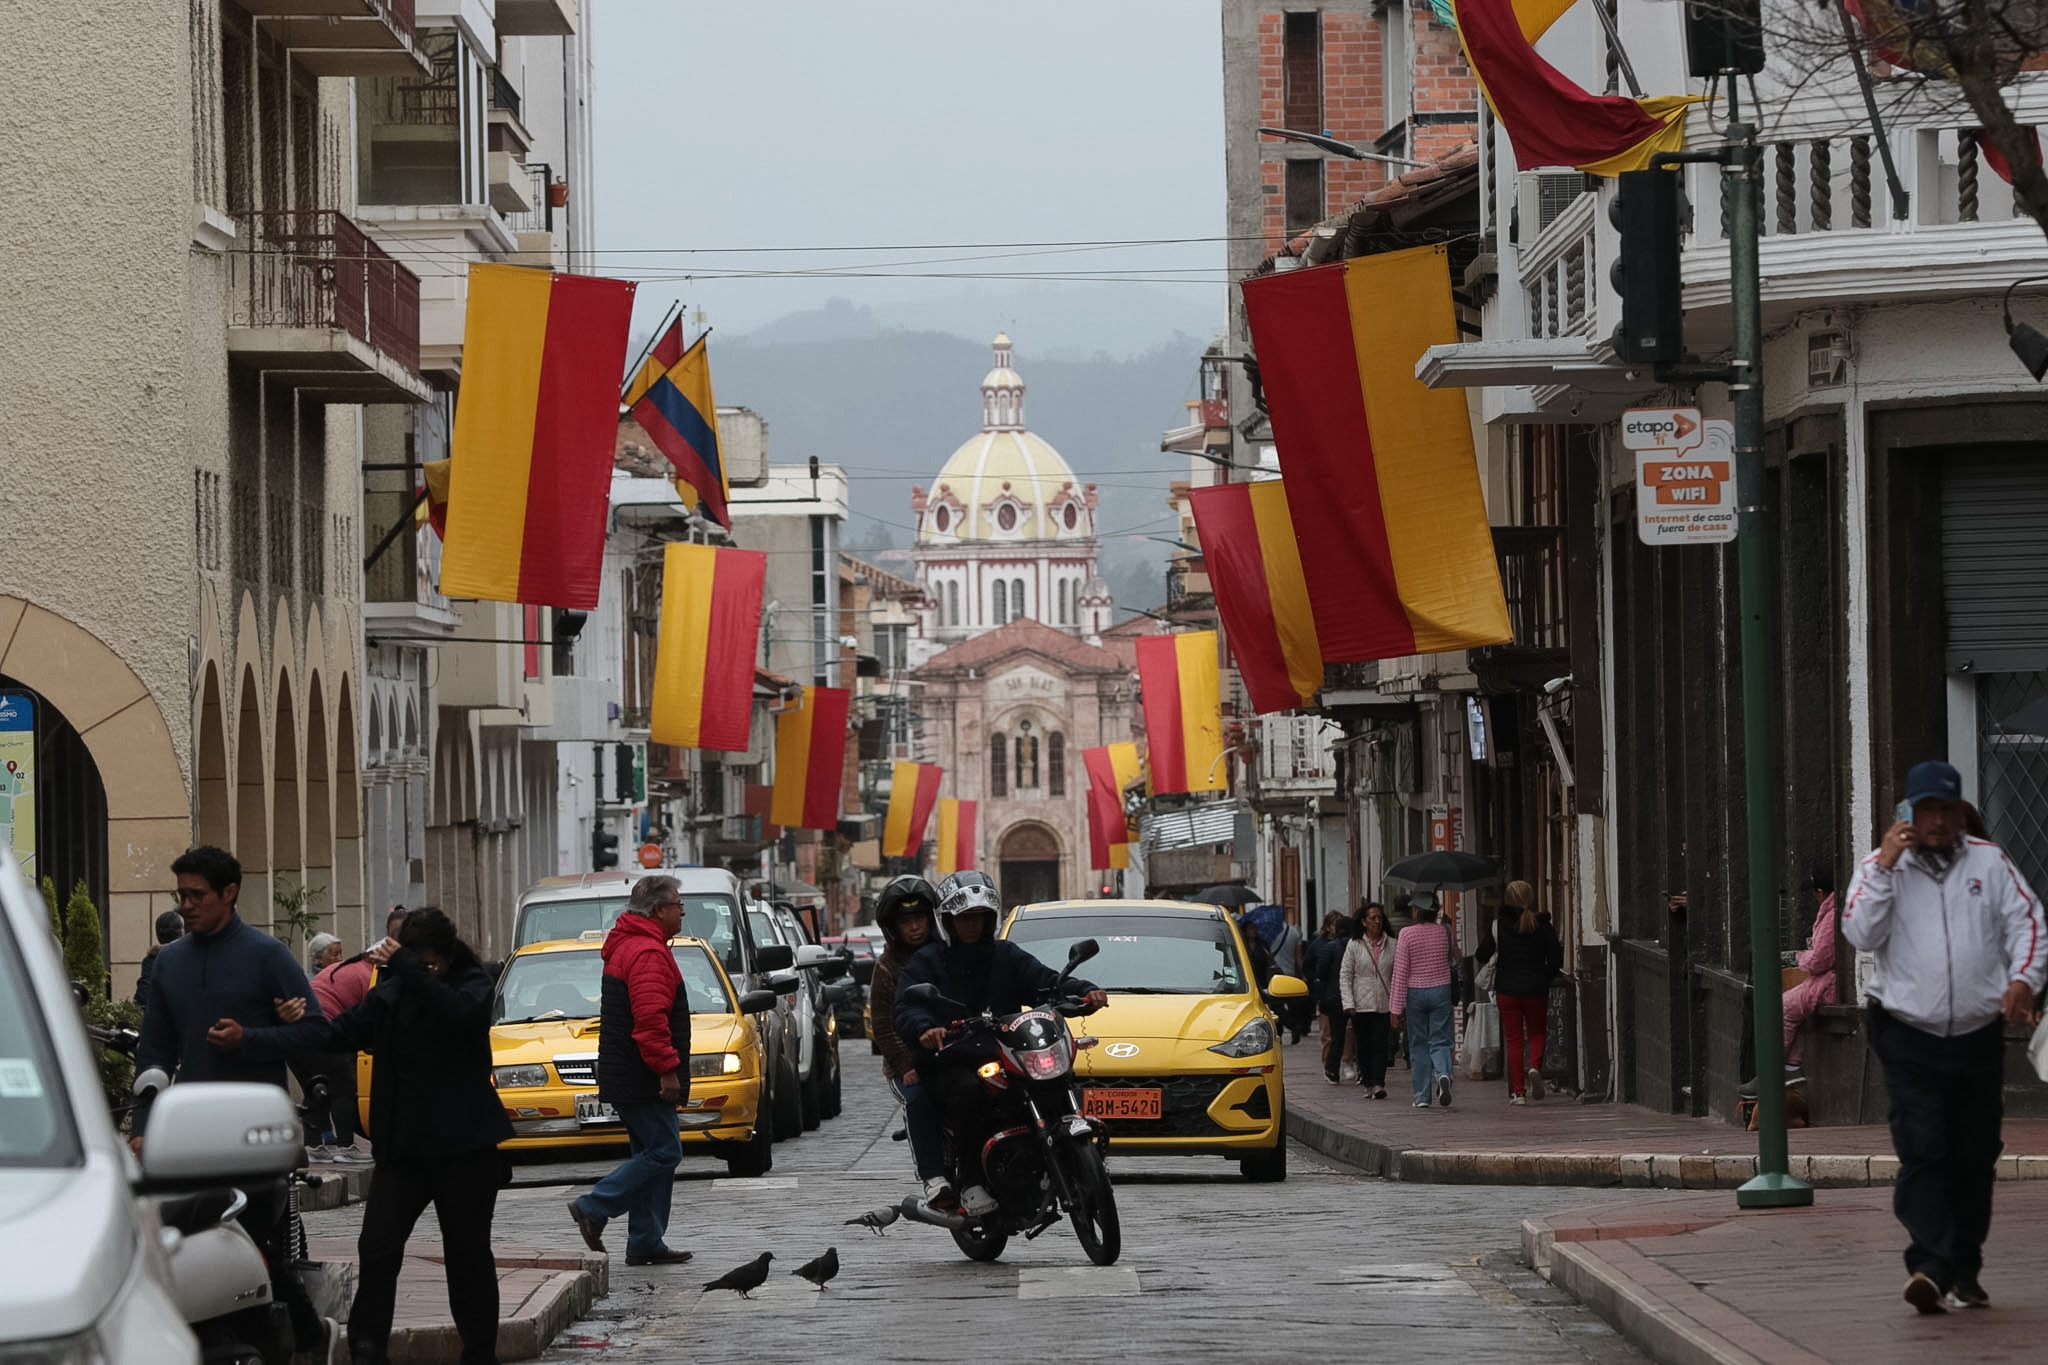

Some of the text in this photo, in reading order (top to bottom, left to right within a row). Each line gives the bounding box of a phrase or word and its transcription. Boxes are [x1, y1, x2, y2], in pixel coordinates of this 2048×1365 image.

[1627, 420, 1674, 436] etapa
[1661, 465, 1713, 481] ZONA
[1672, 487, 1706, 501] WIFI
[1645, 514, 1690, 524] Internet
[1692, 513, 1706, 522] de
[1657, 525, 1685, 535] fuera
[1687, 523, 1701, 532] de
[16, 772, 25, 780] 02
[1107, 935, 1138, 943] TAXI
[1087, 1099, 1160, 1115] ABM-5420
